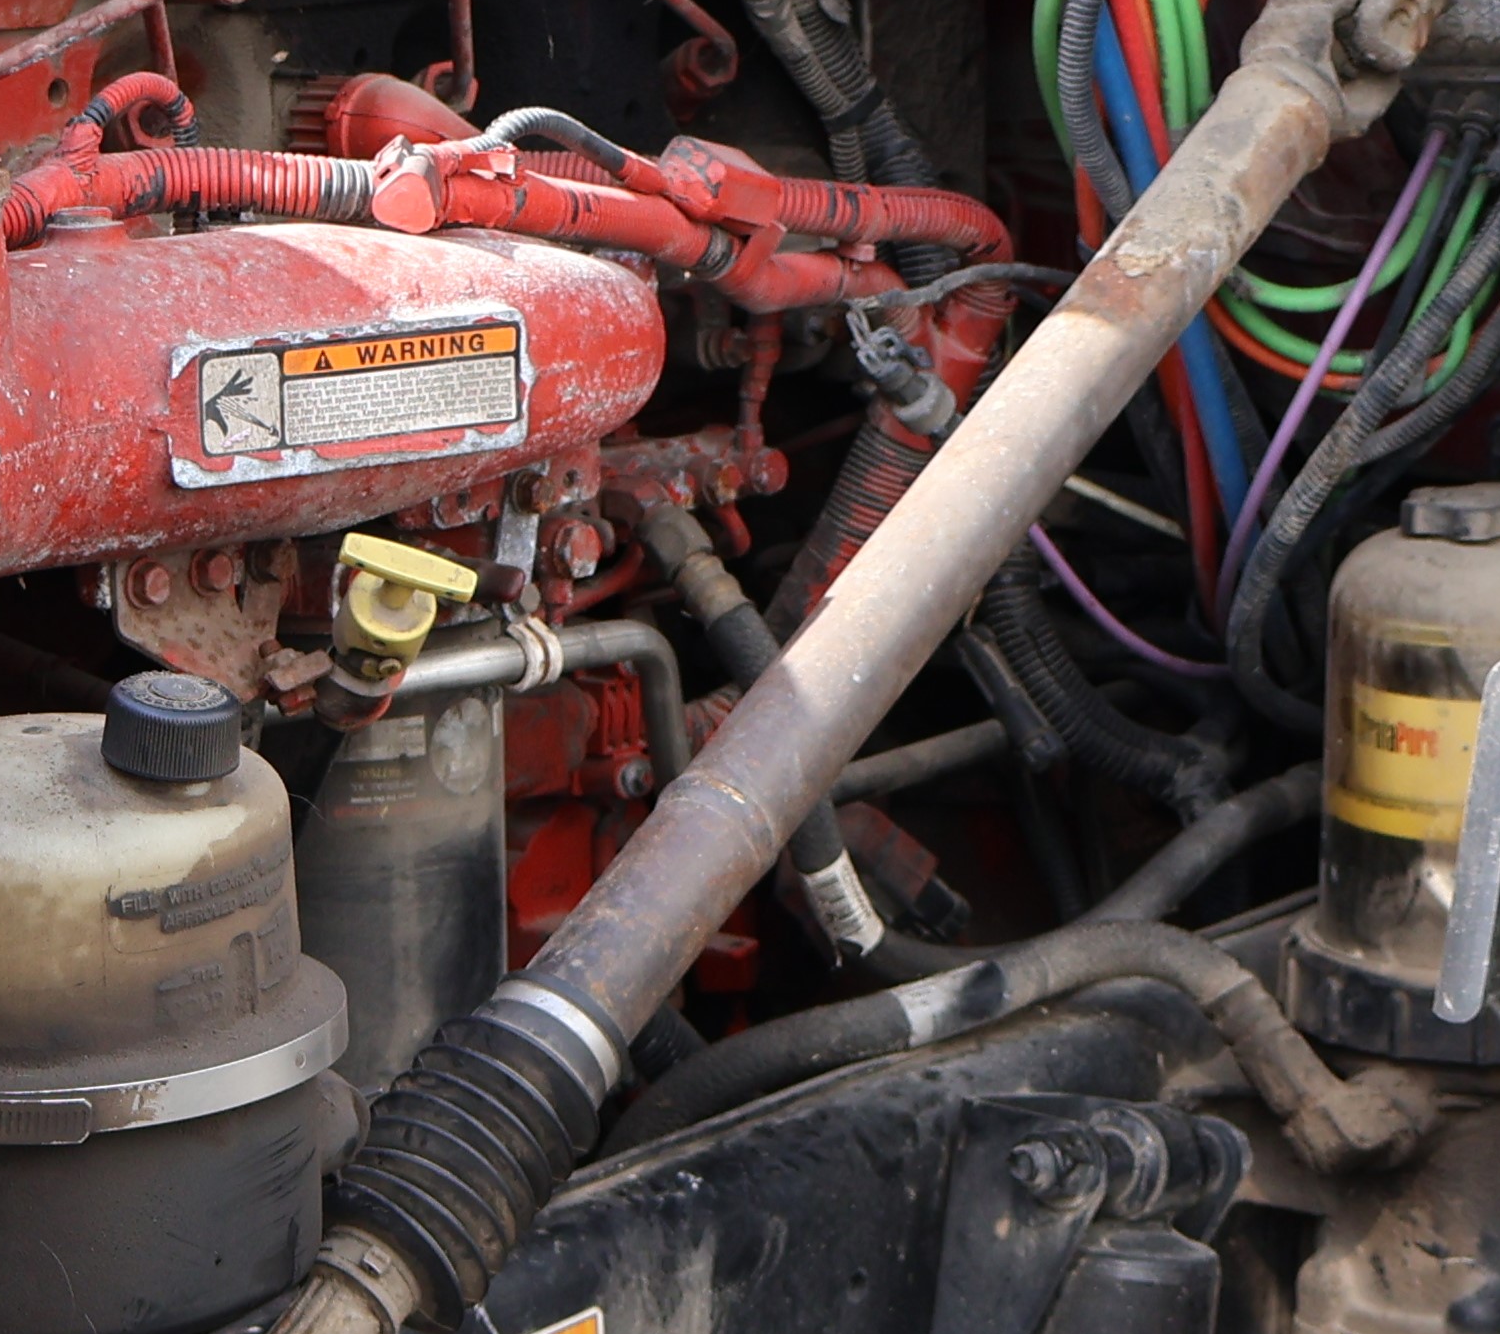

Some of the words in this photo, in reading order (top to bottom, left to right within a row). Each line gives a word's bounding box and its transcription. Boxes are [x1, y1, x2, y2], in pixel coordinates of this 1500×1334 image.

[356, 333, 485, 365] WARNING
[121, 895, 161, 913] FILL
[167, 883, 205, 905] WITH
